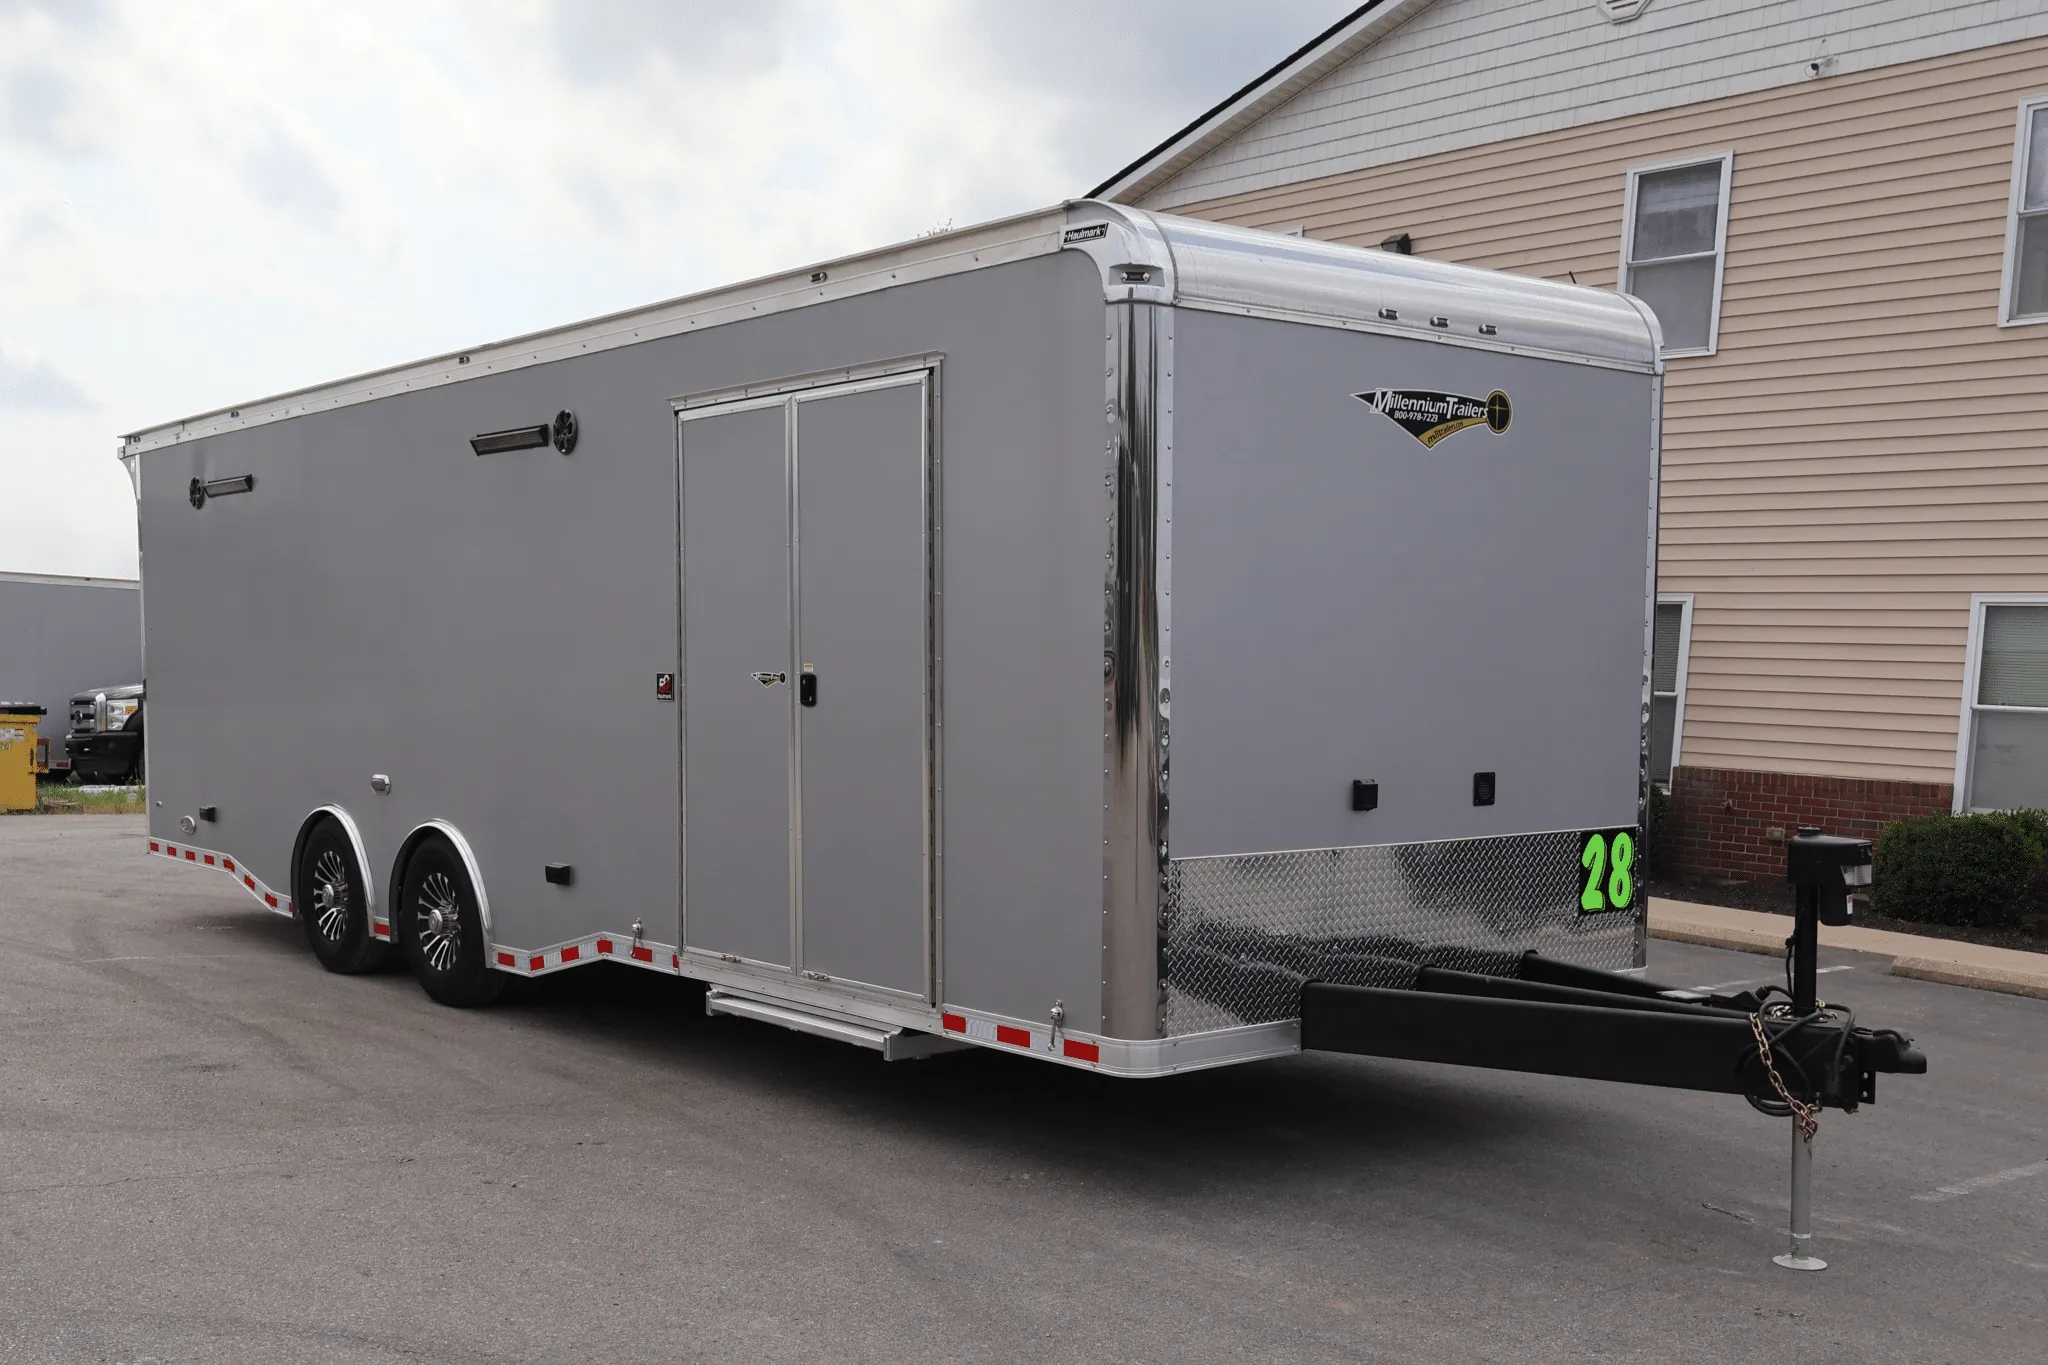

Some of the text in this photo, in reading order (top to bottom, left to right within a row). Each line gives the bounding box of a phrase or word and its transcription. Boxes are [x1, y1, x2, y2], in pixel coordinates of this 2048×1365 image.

[1066, 226, 1102, 241] Haulmark
[1394, 411, 1439, 422] 800-978-7223
[1581, 832, 1634, 911] 28
